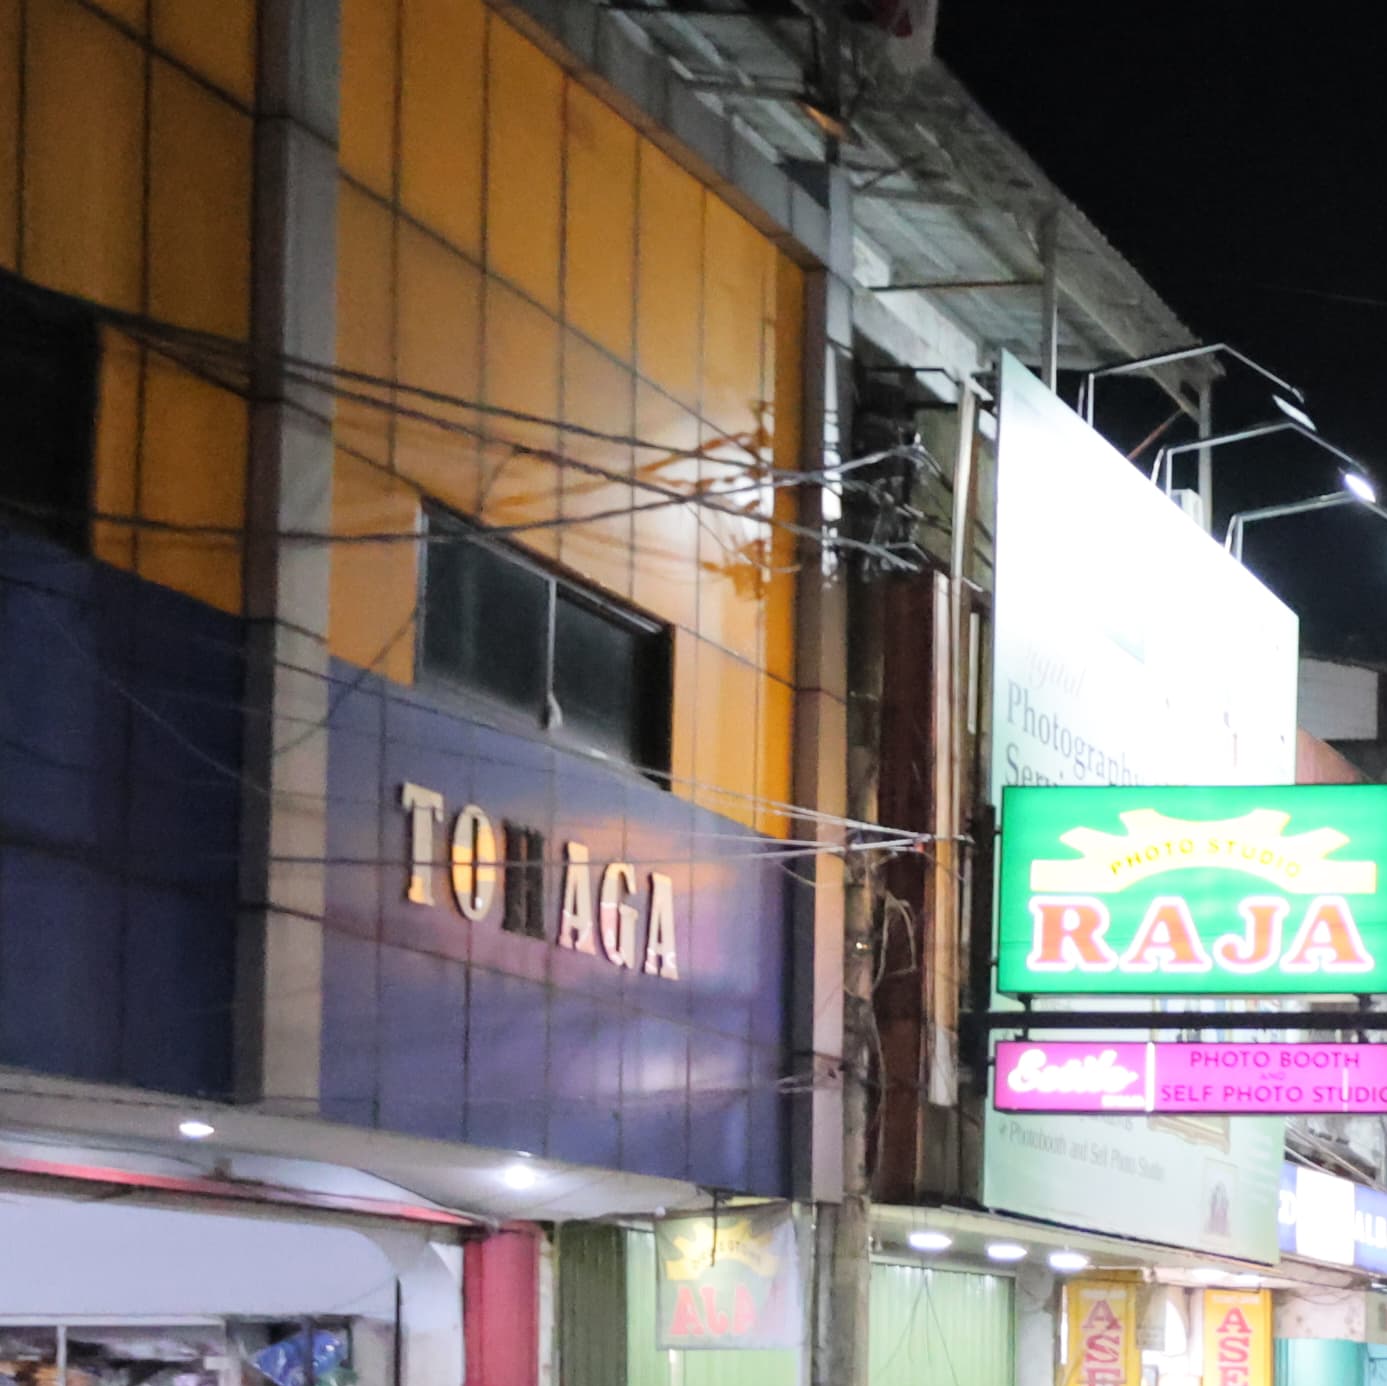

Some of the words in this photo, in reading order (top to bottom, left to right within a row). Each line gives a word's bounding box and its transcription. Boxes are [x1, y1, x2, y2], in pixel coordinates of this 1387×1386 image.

[1006, 681, 1144, 786] Photograph
[1110, 838, 1195, 876] PHOTO
[1208, 838, 1301, 878] STUDIO
[1030, 899, 1372, 968] RAJA
[1190, 1050, 1270, 1068] PHOTO
[1279, 1050, 1360, 1068] BOOTH
[1160, 1085, 1213, 1104] SELF
[1222, 1085, 1304, 1104] PHOTO
